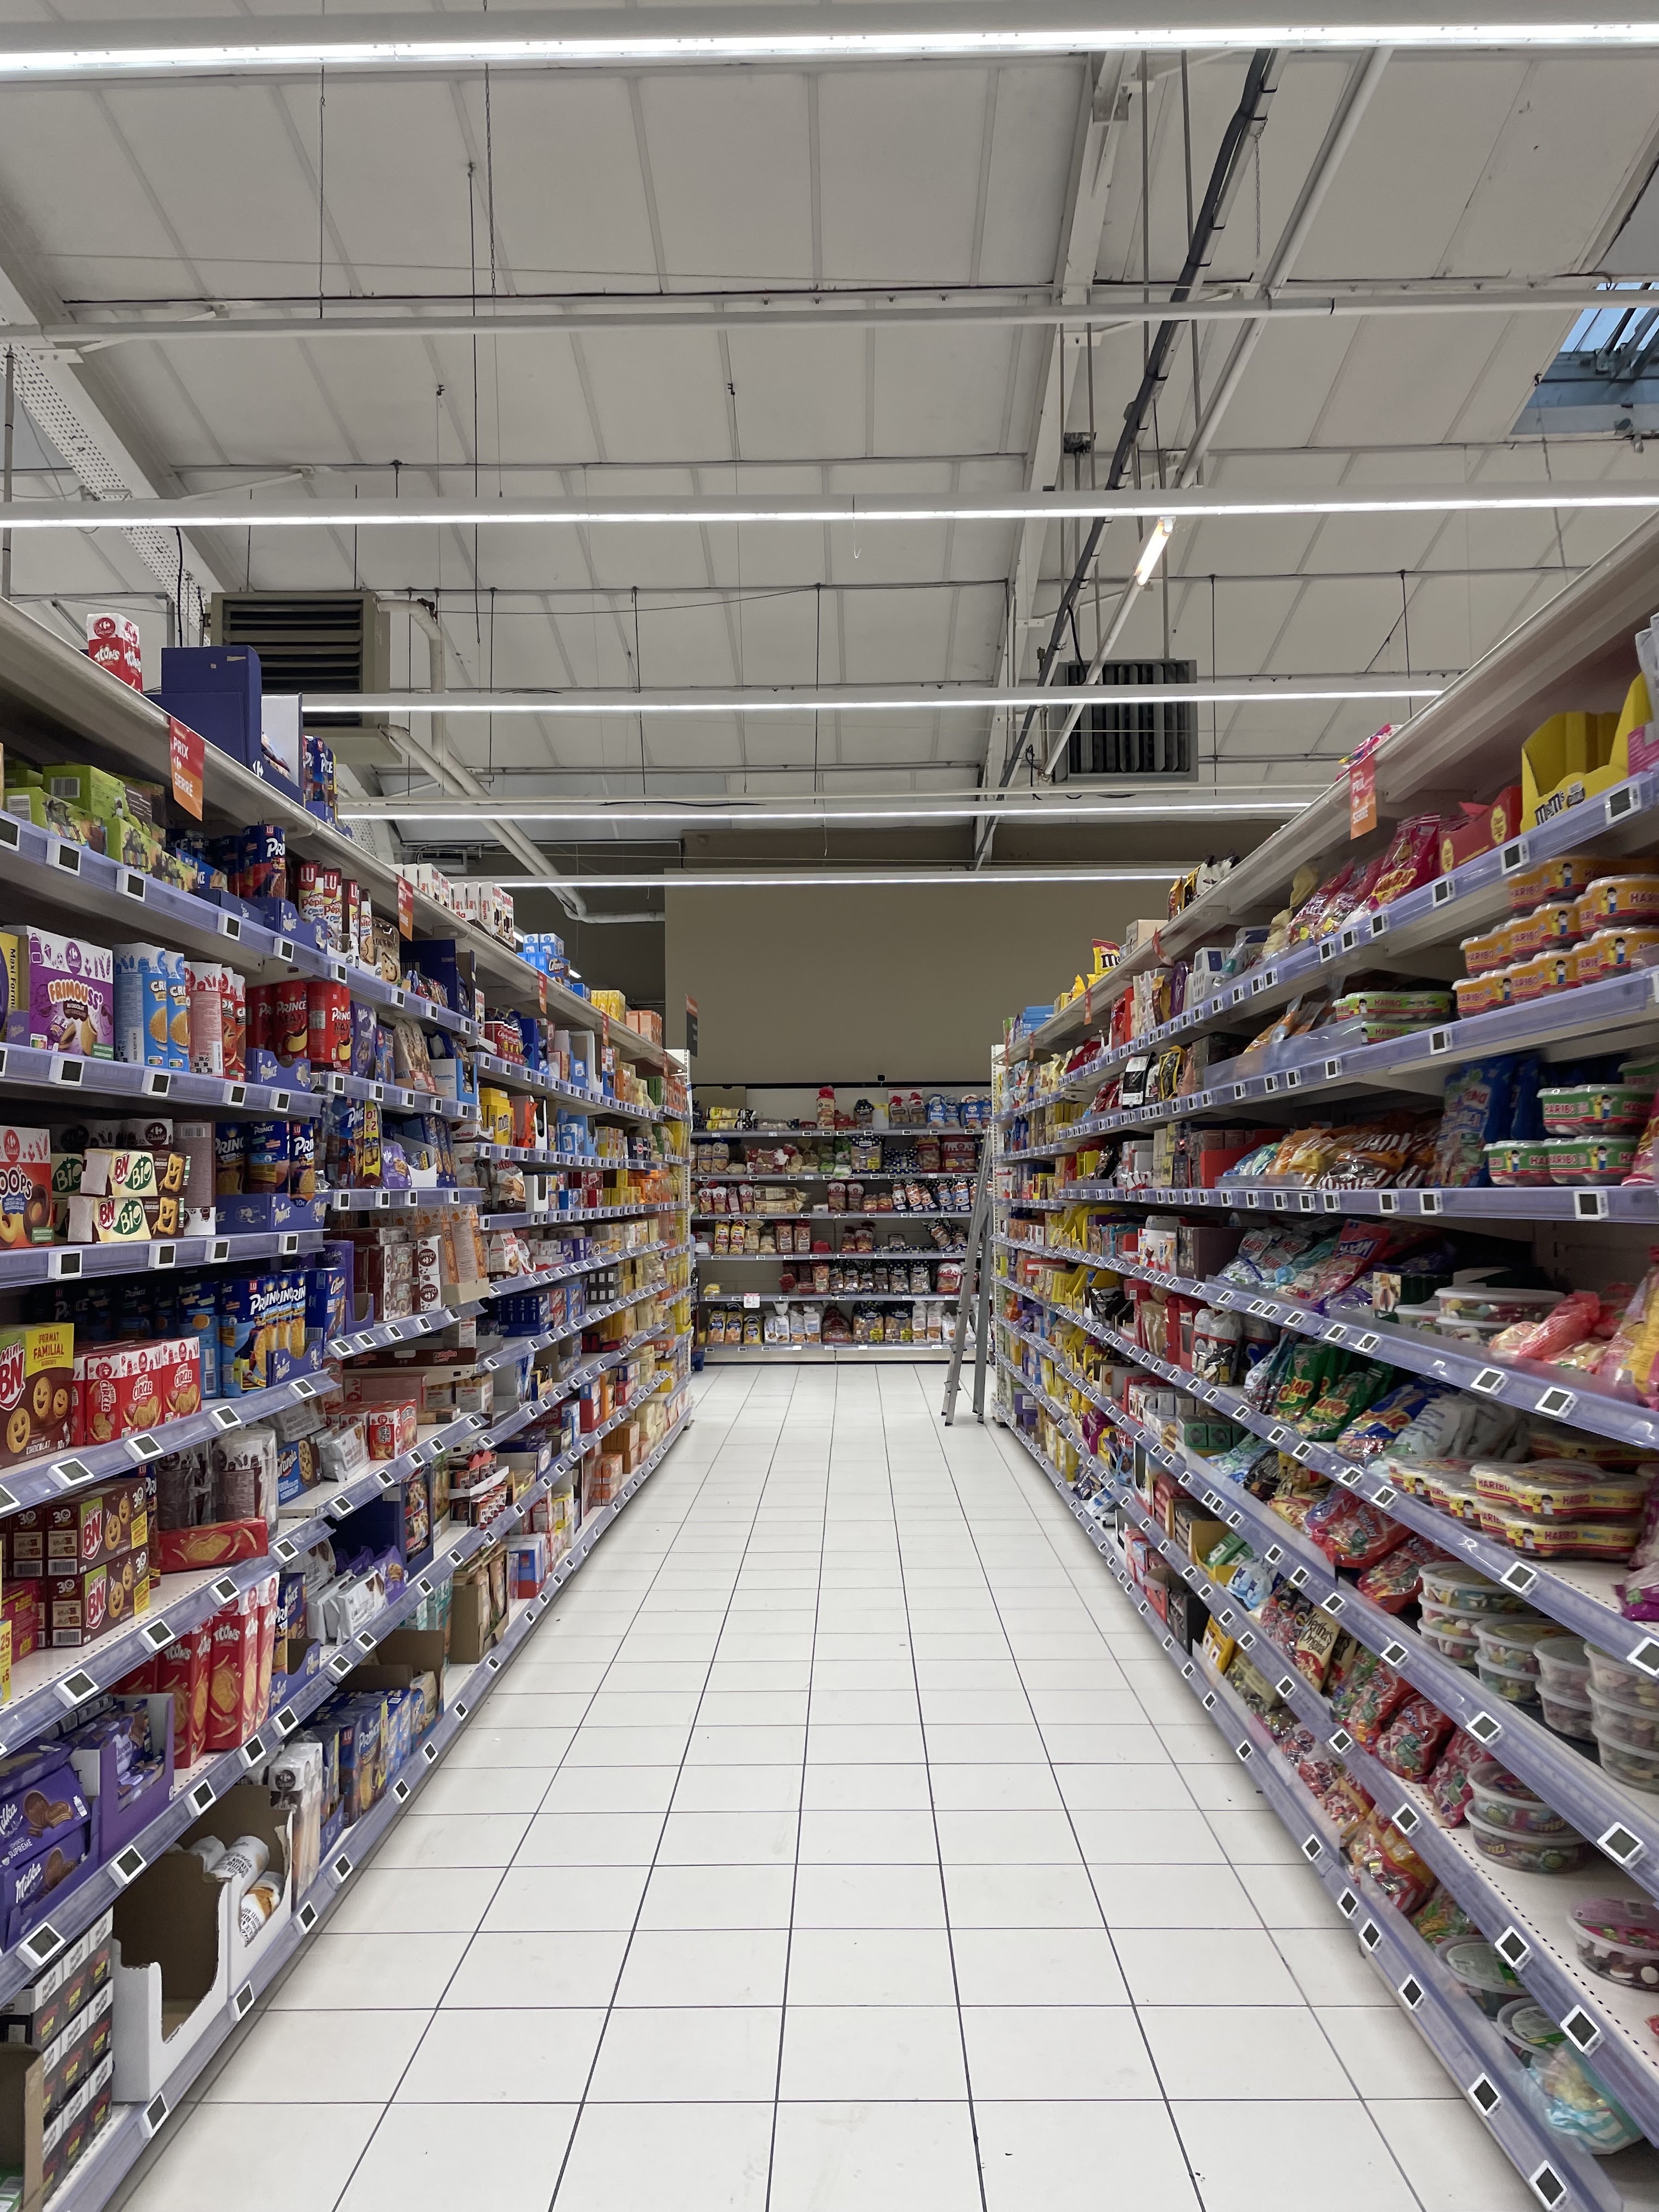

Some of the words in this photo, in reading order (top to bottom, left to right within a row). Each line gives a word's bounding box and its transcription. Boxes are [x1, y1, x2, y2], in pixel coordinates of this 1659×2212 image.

[173, 736, 189, 760] PRIX
[266, 826, 274, 834] LU
[301, 867, 314, 882] LU
[324, 874, 337, 889] LU
[276, 1000, 307, 1014] PRINCE
[254, 1125, 274, 1135] PRINCE
[294, 1125, 301, 1135] LU
[114, 1153, 131, 1182] BN
[99, 1200, 116, 1226] BN
[250, 1282, 257, 1290] LU
[38, 1332, 59, 1344] FORMAT
[33, 1344, 64, 1359] FAMILIAL
[0, 1353, 24, 1400] BN
[174, 1370, 192, 1387] CIRCLE
[100, 1380, 111, 1412] CIRCLE
[133, 1381, 153, 1400] CIRCLE
[83, 1515, 101, 1553] BN
[87, 1585, 105, 1621] BN
[1300, 1628, 1329, 1656] Original
[343, 1729, 352, 1742] LU
[8, 1838, 32, 1858] SUPREME
[15, 1863, 42, 1904] Milka
